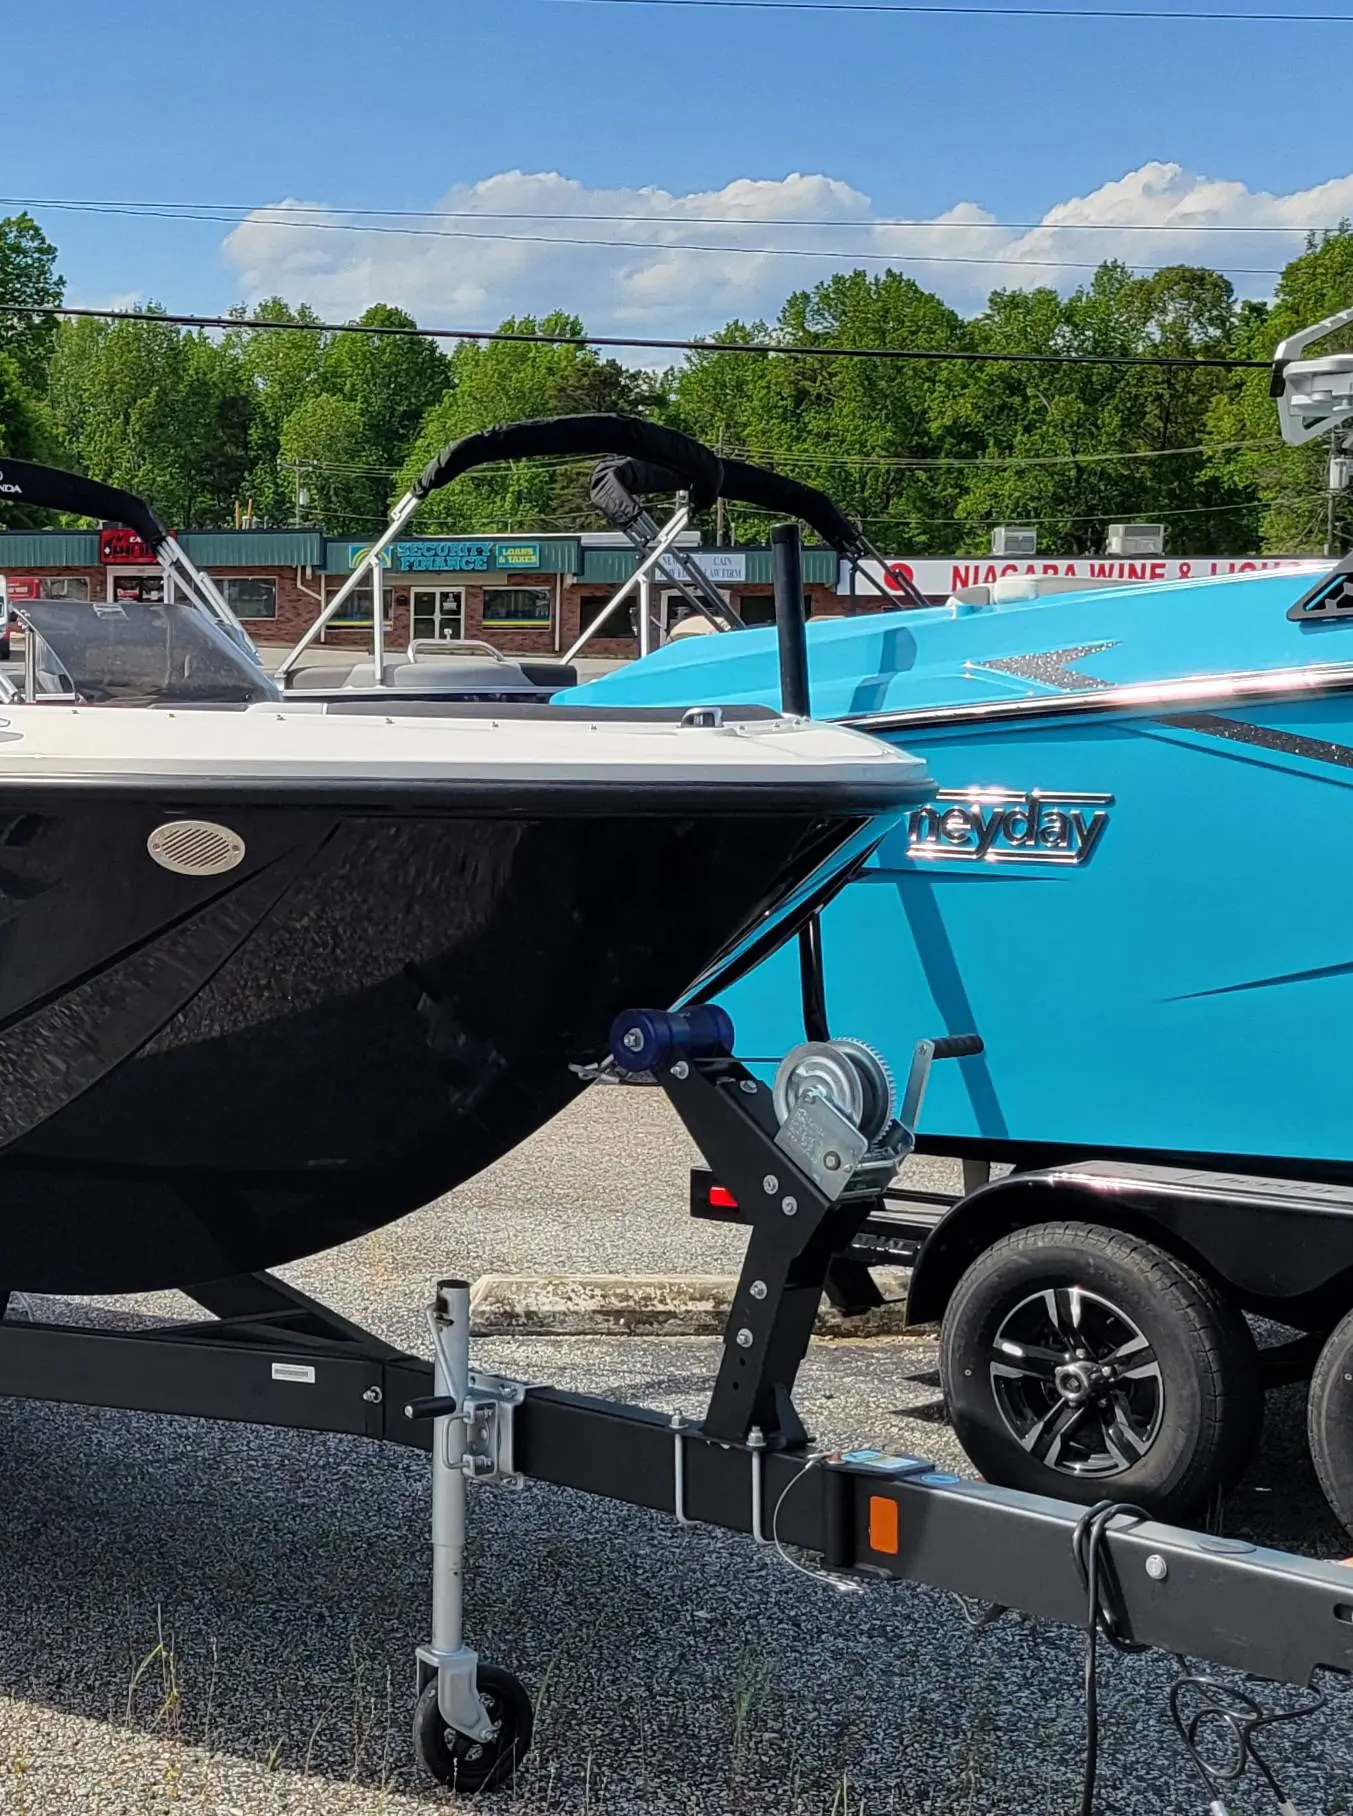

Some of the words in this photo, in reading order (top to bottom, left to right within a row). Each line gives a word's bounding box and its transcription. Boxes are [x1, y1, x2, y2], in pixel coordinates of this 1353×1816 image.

[397, 542, 493, 557] SECURITY
[502, 547, 534, 555] LOANS
[400, 556, 488, 571] FINANCE
[508, 556, 537, 564] TAXES
